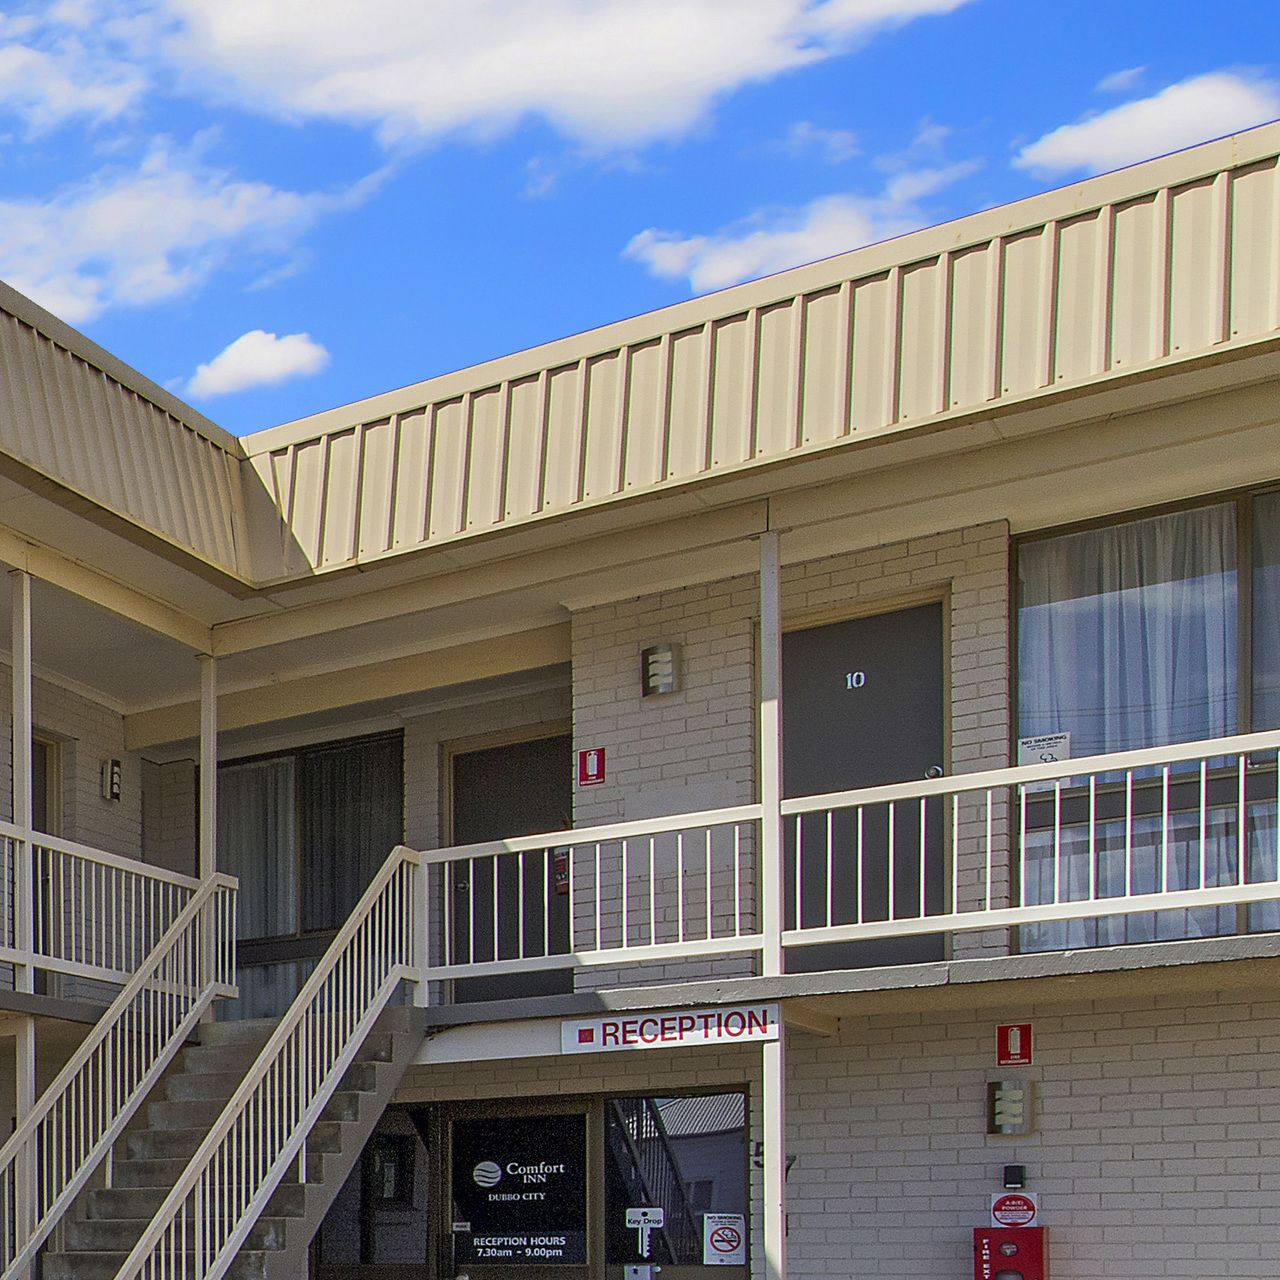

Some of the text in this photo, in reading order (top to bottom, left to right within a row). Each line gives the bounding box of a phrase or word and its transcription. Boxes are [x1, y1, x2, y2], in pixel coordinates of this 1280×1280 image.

[846, 672, 865, 689] 10
[601, 1010, 768, 1046] RECEPTION
[506, 1162, 565, 1175] Comfort
[523, 1174, 547, 1183] INN
[488, 1192, 546, 1201] DUBBO CITY
[627, 1218, 662, 1226] Key Drop
[473, 1236, 566, 1246] RECEPTION HOURS
[477, 1249, 512, 1257] 7.30am
[525, 1248, 562, 1258] 9.00pm
